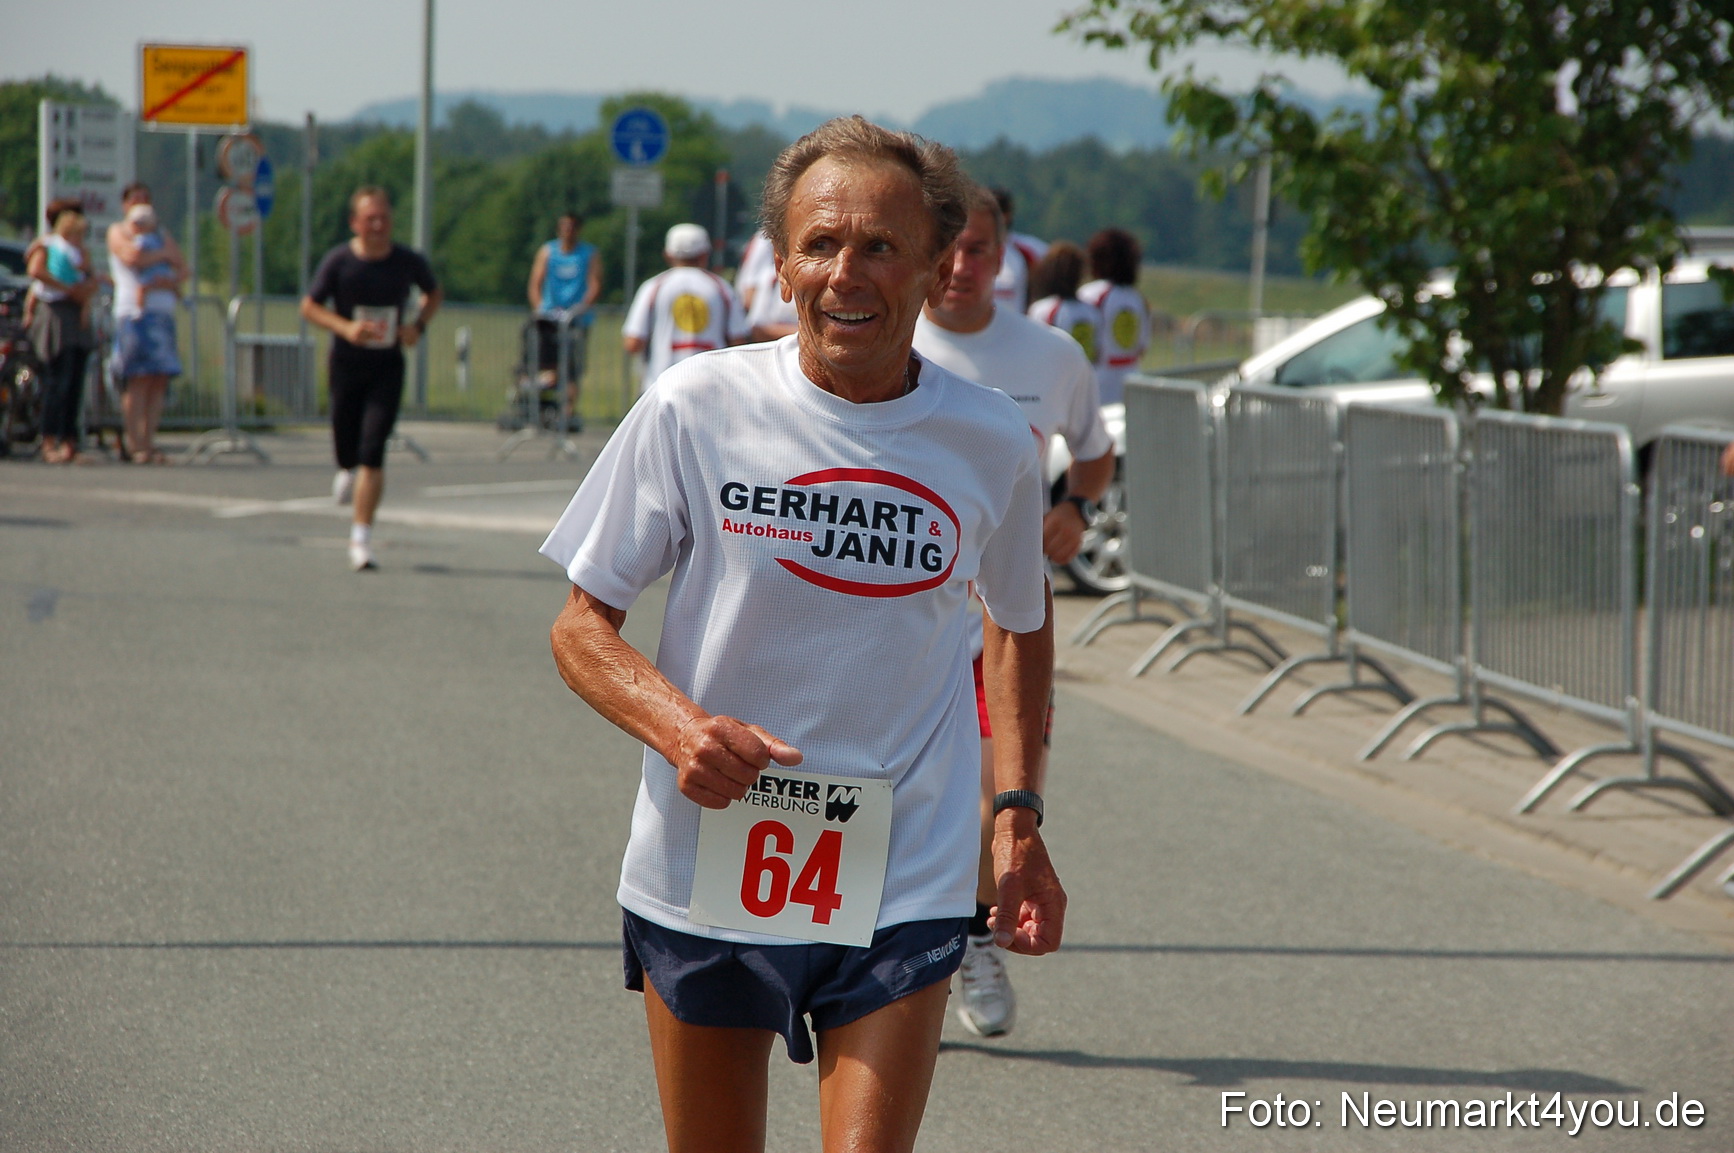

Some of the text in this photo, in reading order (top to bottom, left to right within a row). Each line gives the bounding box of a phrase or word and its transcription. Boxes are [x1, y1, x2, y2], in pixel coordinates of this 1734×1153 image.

[720, 482, 942, 537] GERHART &
[722, 518, 943, 572] Autohaus JÄNIG
[740, 820, 842, 925] 64
